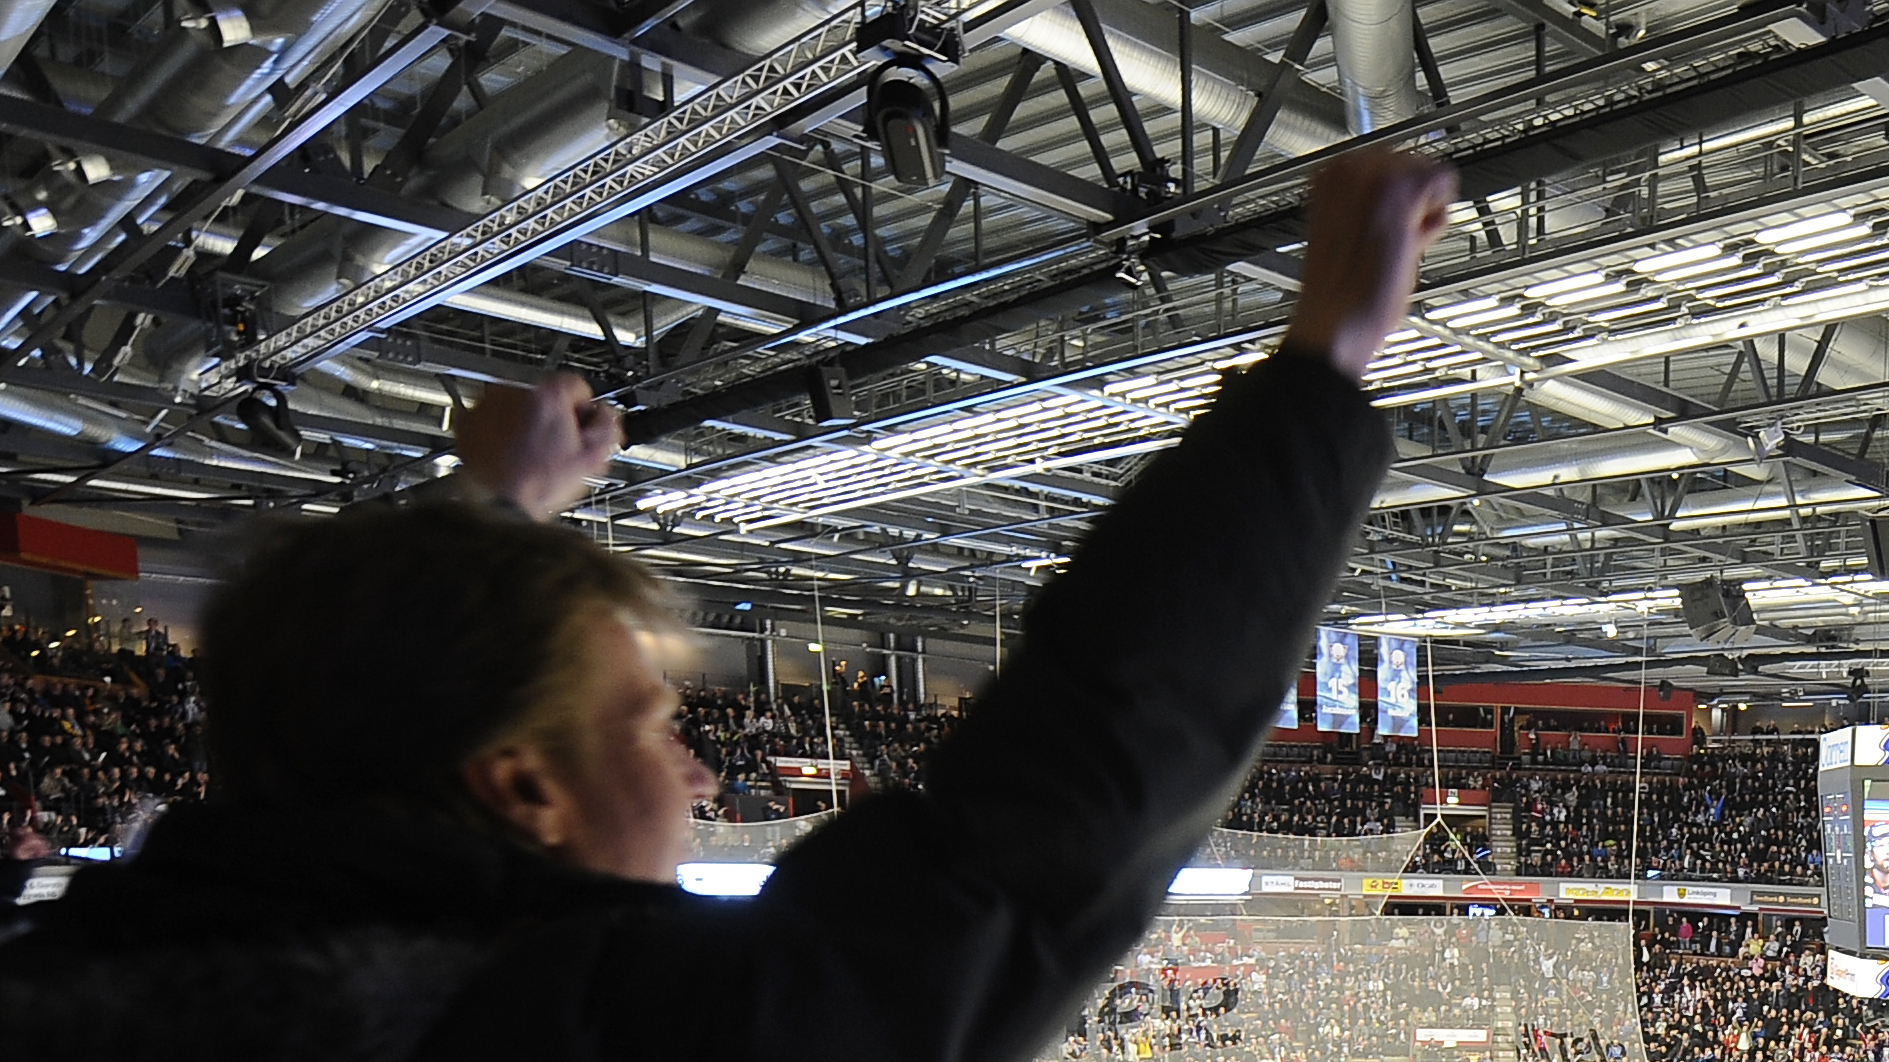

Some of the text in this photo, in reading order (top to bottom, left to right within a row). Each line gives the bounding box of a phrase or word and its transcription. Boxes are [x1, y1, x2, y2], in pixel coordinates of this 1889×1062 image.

[1328, 677, 1349, 700] 15
[1387, 680, 1409, 704] 16
[1687, 888, 1718, 899] Linköping
